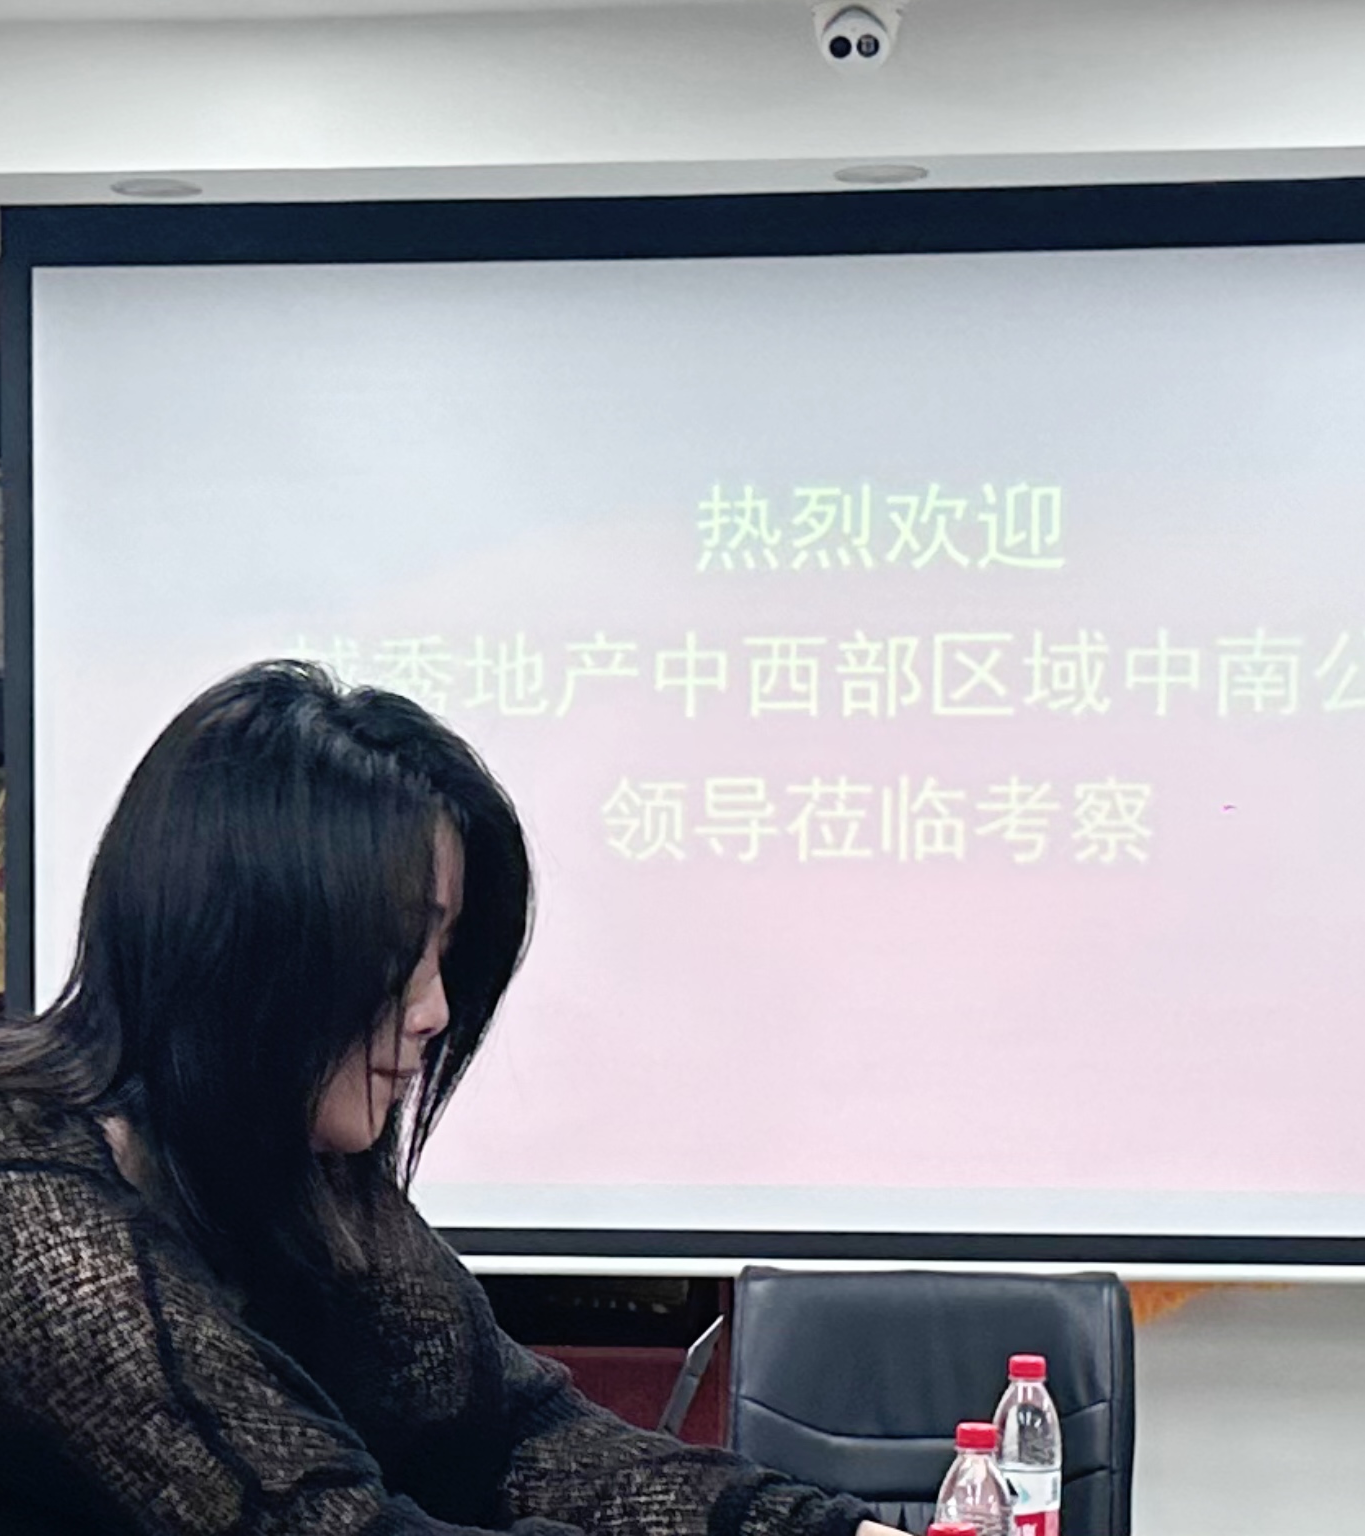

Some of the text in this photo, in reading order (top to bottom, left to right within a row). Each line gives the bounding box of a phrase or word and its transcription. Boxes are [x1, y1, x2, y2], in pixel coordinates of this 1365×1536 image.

[695, 482, 1067, 572] 热烈欢迎
[602, 774, 1155, 866] 领导莅临考察
